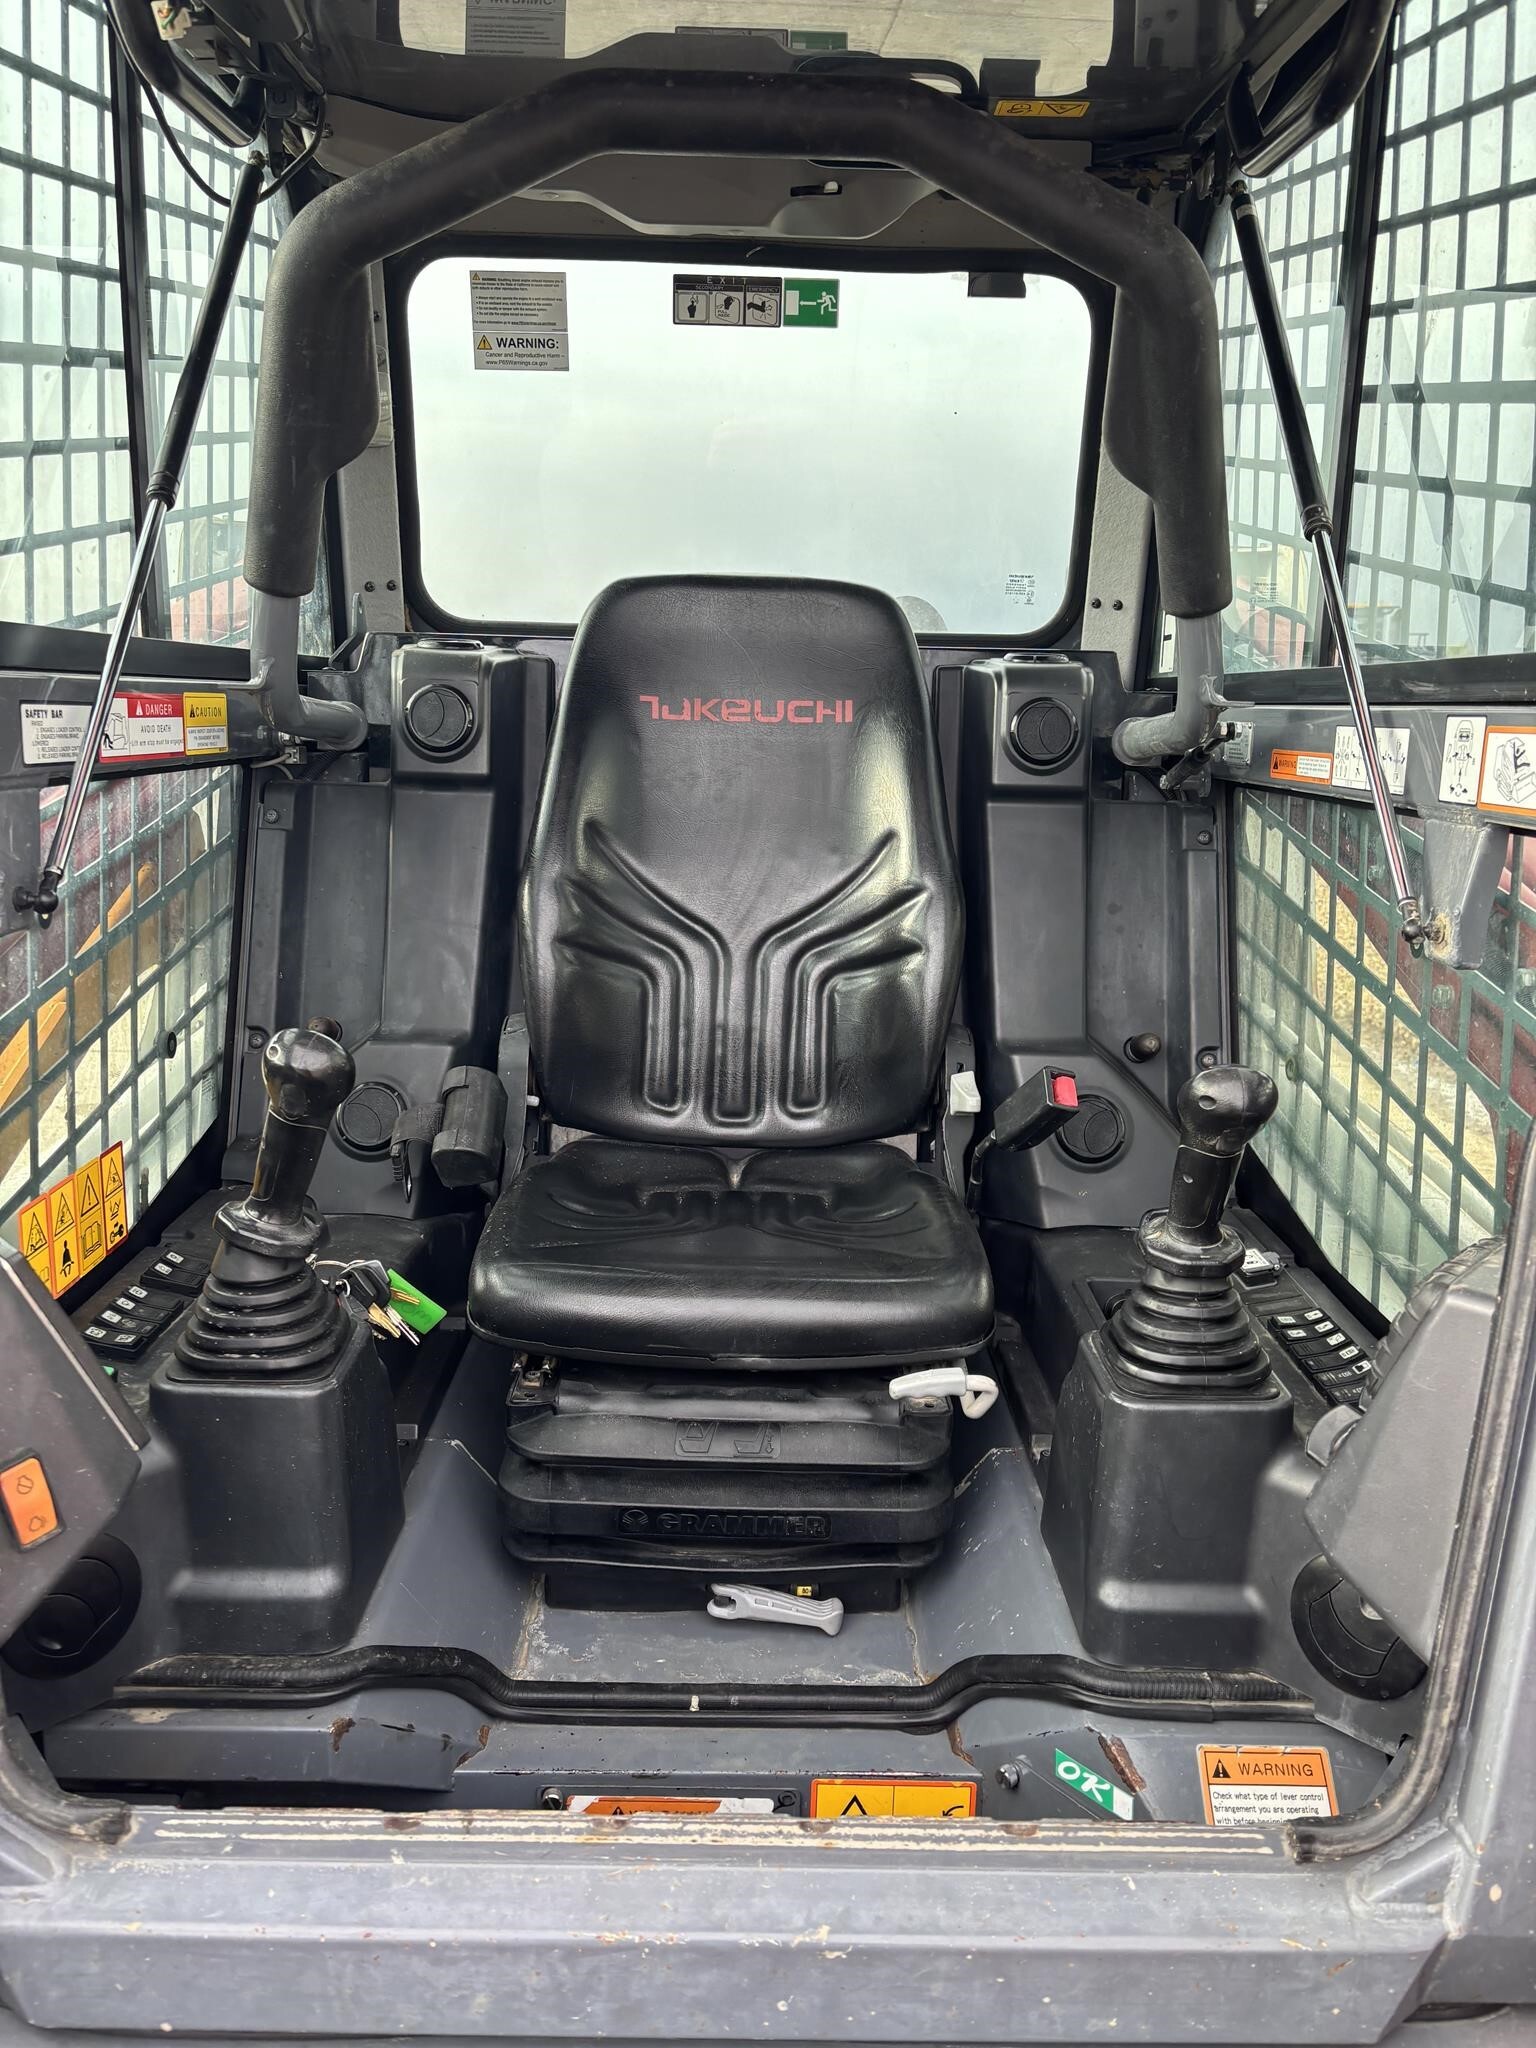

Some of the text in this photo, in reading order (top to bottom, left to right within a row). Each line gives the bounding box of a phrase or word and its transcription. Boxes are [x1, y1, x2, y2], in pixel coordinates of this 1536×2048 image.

[496, 337, 559, 349] WARNING:
[25, 709, 63, 718] SAFETY BAR
[145, 703, 173, 715] DANGER
[195, 707, 222, 718] CAUTION
[141, 724, 171, 733] AVOID DEATH
[657, 1513, 826, 1537] GRAMMER
[1238, 1762, 1314, 1777] WARNING
[1058, 1761, 1111, 1802] OK
[1212, 1791, 1324, 1802] Check what type of lever control
[1213, 1804, 1319, 1815] arrangement you are operating
[1216, 1816, 1232, 1825] with
[1233, 1817, 1255, 1825] before
